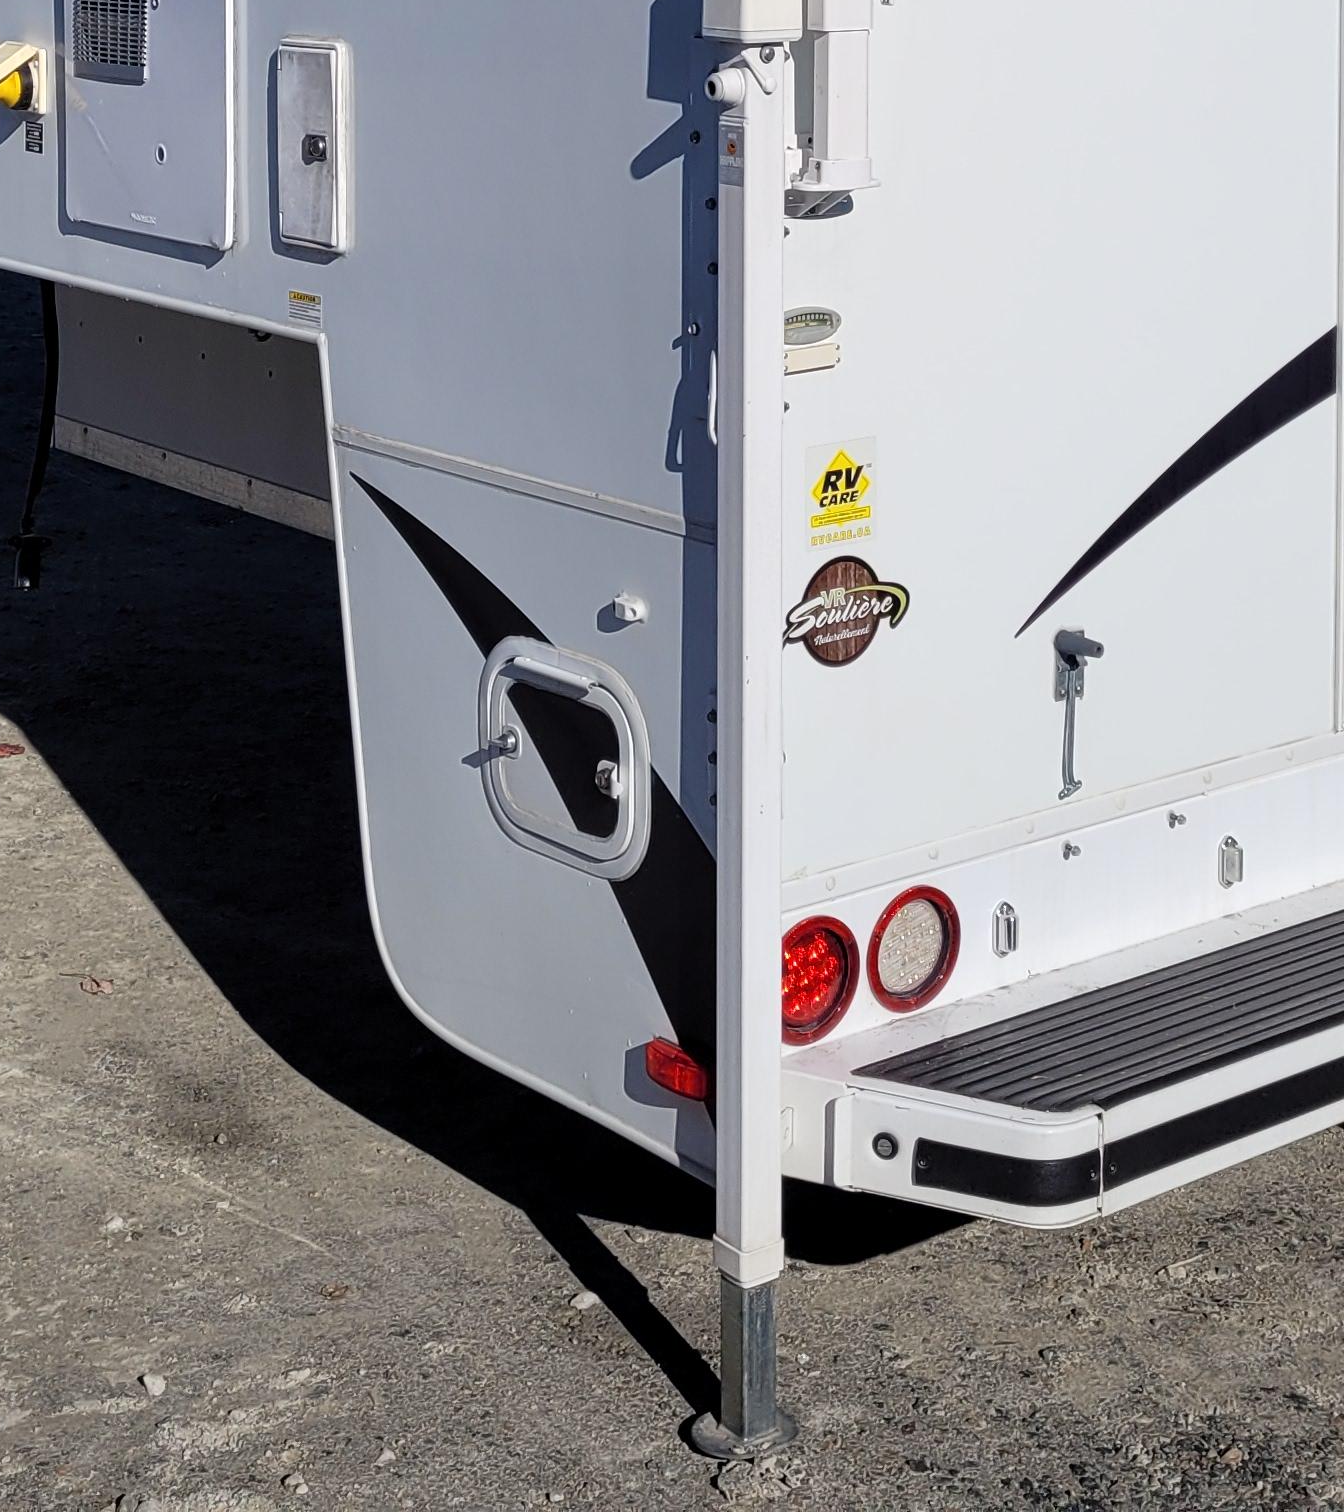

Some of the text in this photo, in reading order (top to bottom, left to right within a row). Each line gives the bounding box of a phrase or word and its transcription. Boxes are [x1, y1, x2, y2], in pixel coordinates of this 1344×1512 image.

[821, 464, 864, 494] RV
[819, 490, 860, 508] CARE
[820, 587, 846, 609] VR
[782, 595, 894, 639] Soulière
